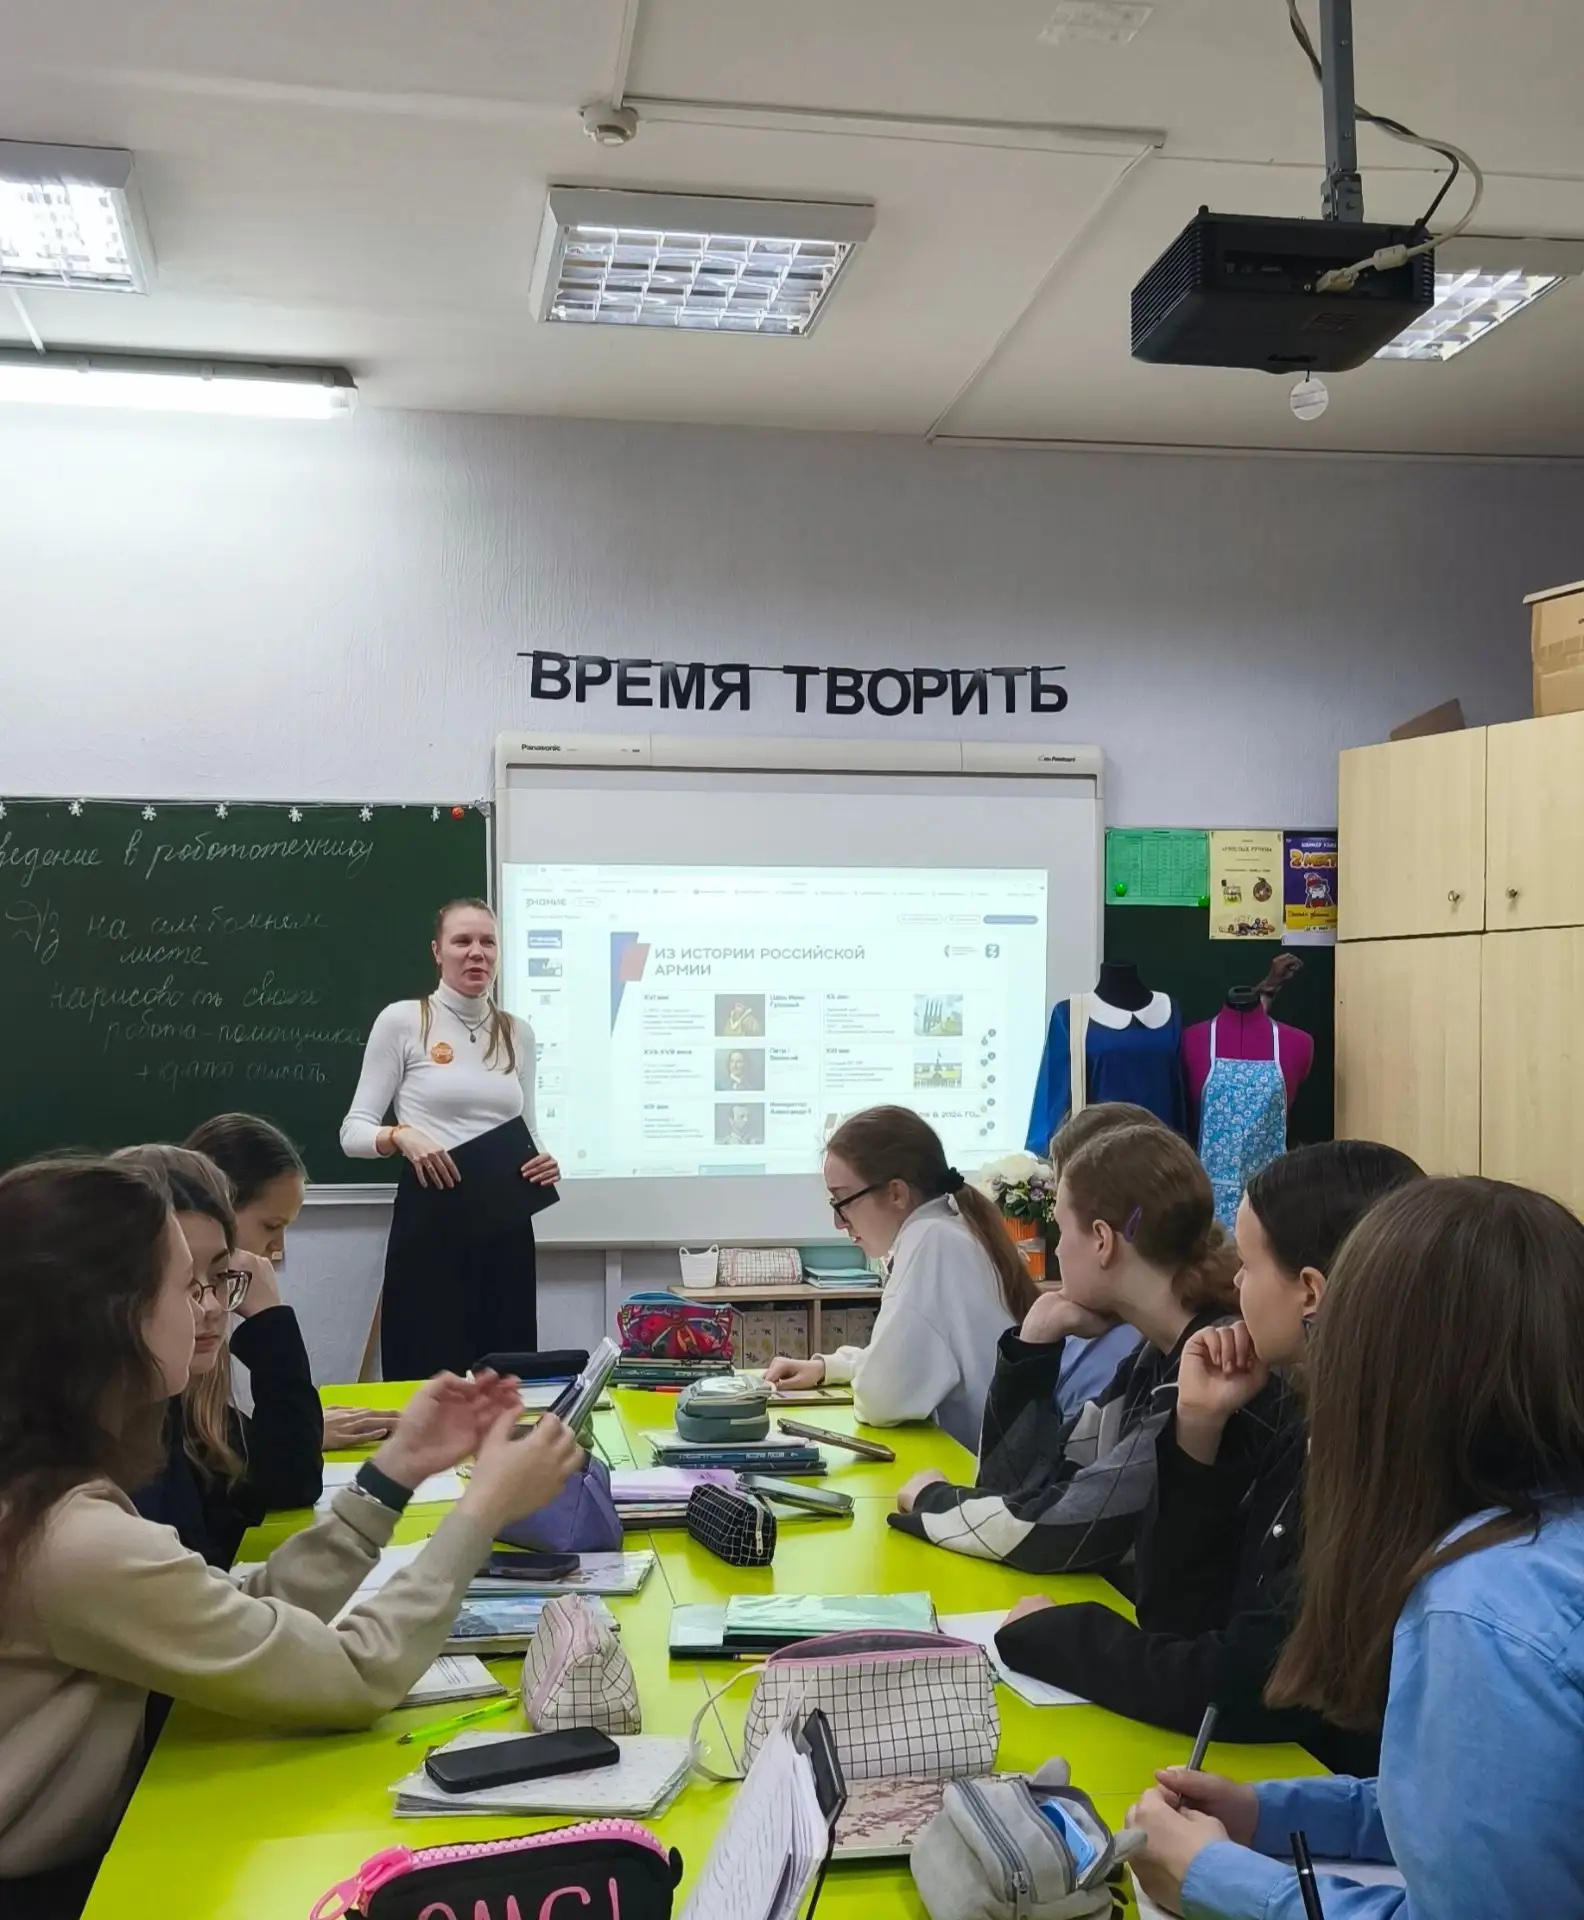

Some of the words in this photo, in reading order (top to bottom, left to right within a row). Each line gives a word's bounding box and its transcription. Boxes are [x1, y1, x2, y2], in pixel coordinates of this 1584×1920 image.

[531, 650, 750, 711] ВРЕМЯ
[783, 665, 1068, 716] ТВОРИТЬ
[521, 743, 561, 752] Panasonic
[124, 829, 143, 866] в
[87, 915, 133, 940] на
[119, 945, 208, 964] листе
[654, 947, 676, 959] ИЗ
[681, 947, 755, 960] ИСТОРИИ
[760, 945, 865, 960] РОССИЙСКОЙ
[654, 964, 712, 976] АРМИИ
